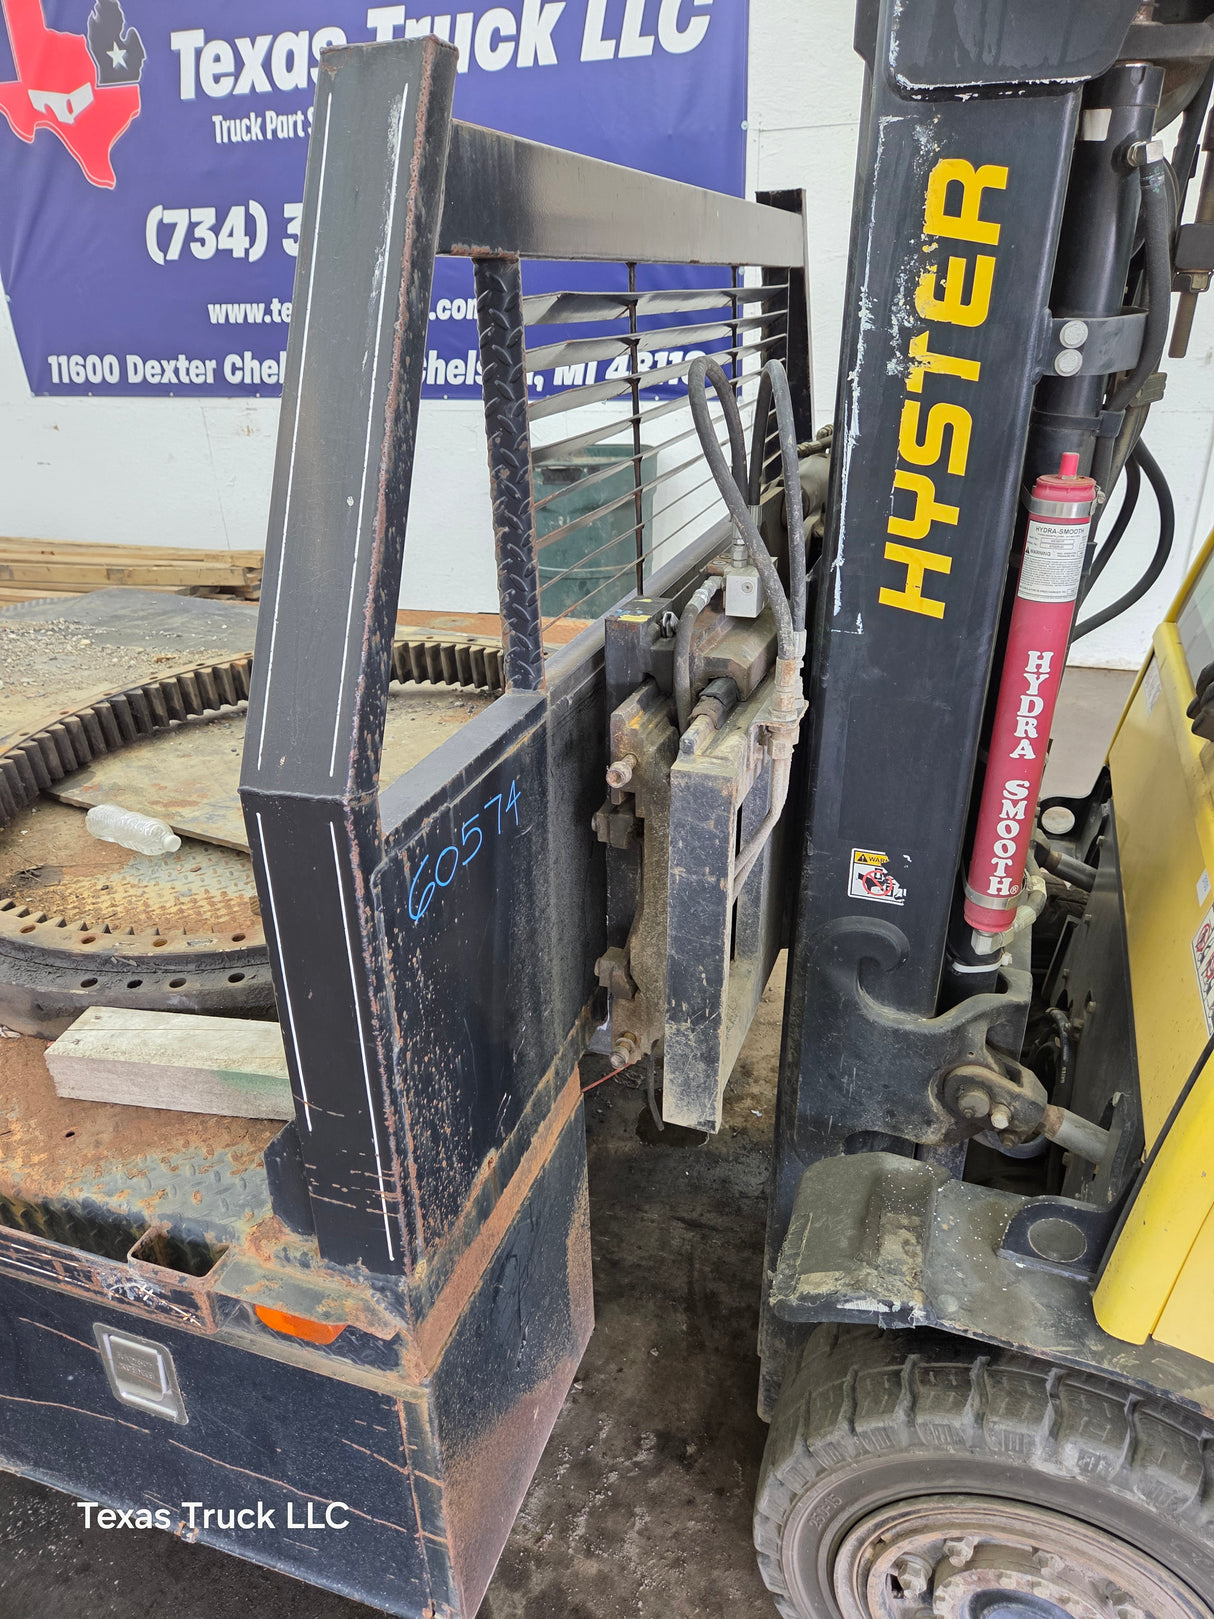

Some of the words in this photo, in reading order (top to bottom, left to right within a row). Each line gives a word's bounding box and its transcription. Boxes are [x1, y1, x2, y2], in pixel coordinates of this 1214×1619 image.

[580, 0, 713, 62] LLC
[212, 111, 262, 144] Truck
[266, 109, 305, 139] Part
[146, 200, 268, 266] (734)
[48, 354, 120, 384] 11600
[126, 353, 217, 384] Dexter
[553, 360, 598, 386] MI
[879, 157, 1009, 620] HYSTER
[1010, 650, 1054, 760] HYDRA
[408, 779, 522, 924] 60574
